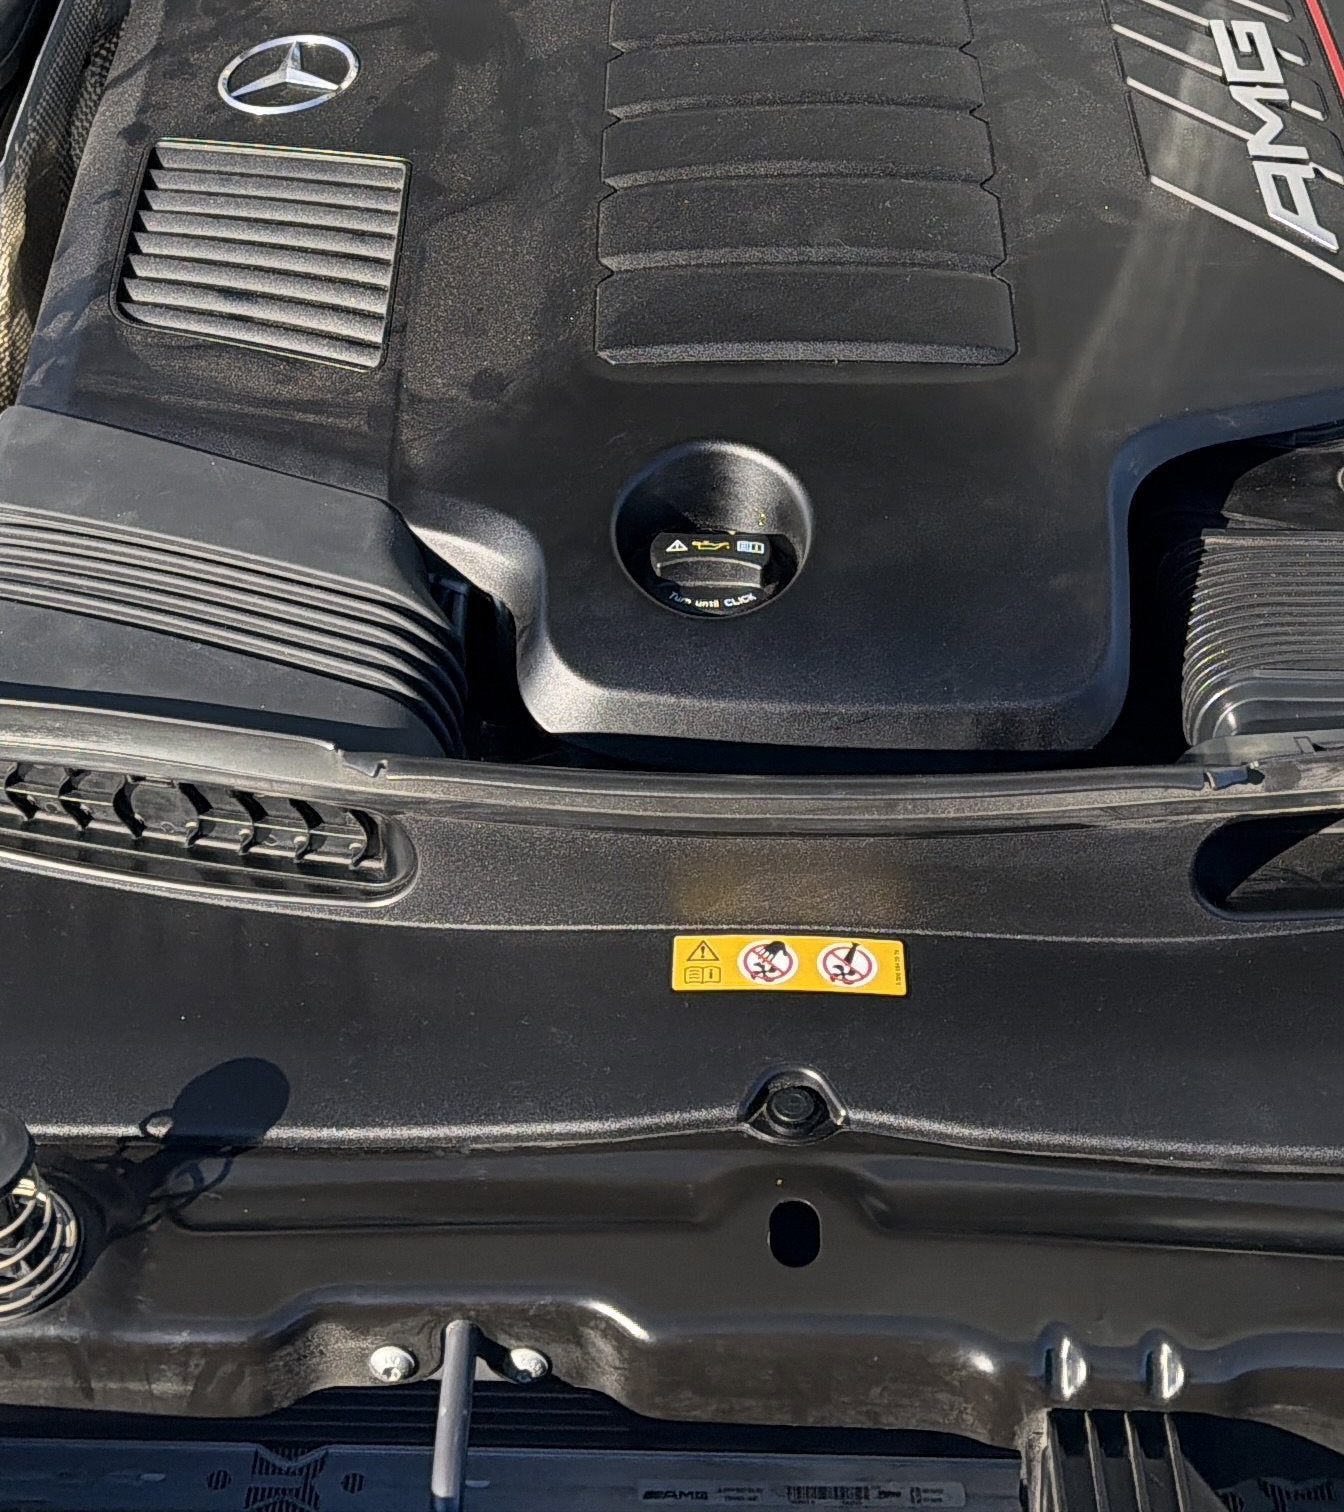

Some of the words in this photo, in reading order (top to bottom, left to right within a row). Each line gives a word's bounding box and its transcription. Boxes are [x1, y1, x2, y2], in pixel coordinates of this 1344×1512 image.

[1208, 19, 1340, 253] AMG
[668, 591, 692, 605] Turn
[694, 599, 720, 608] until
[723, 592, 757, 607] CLICK
